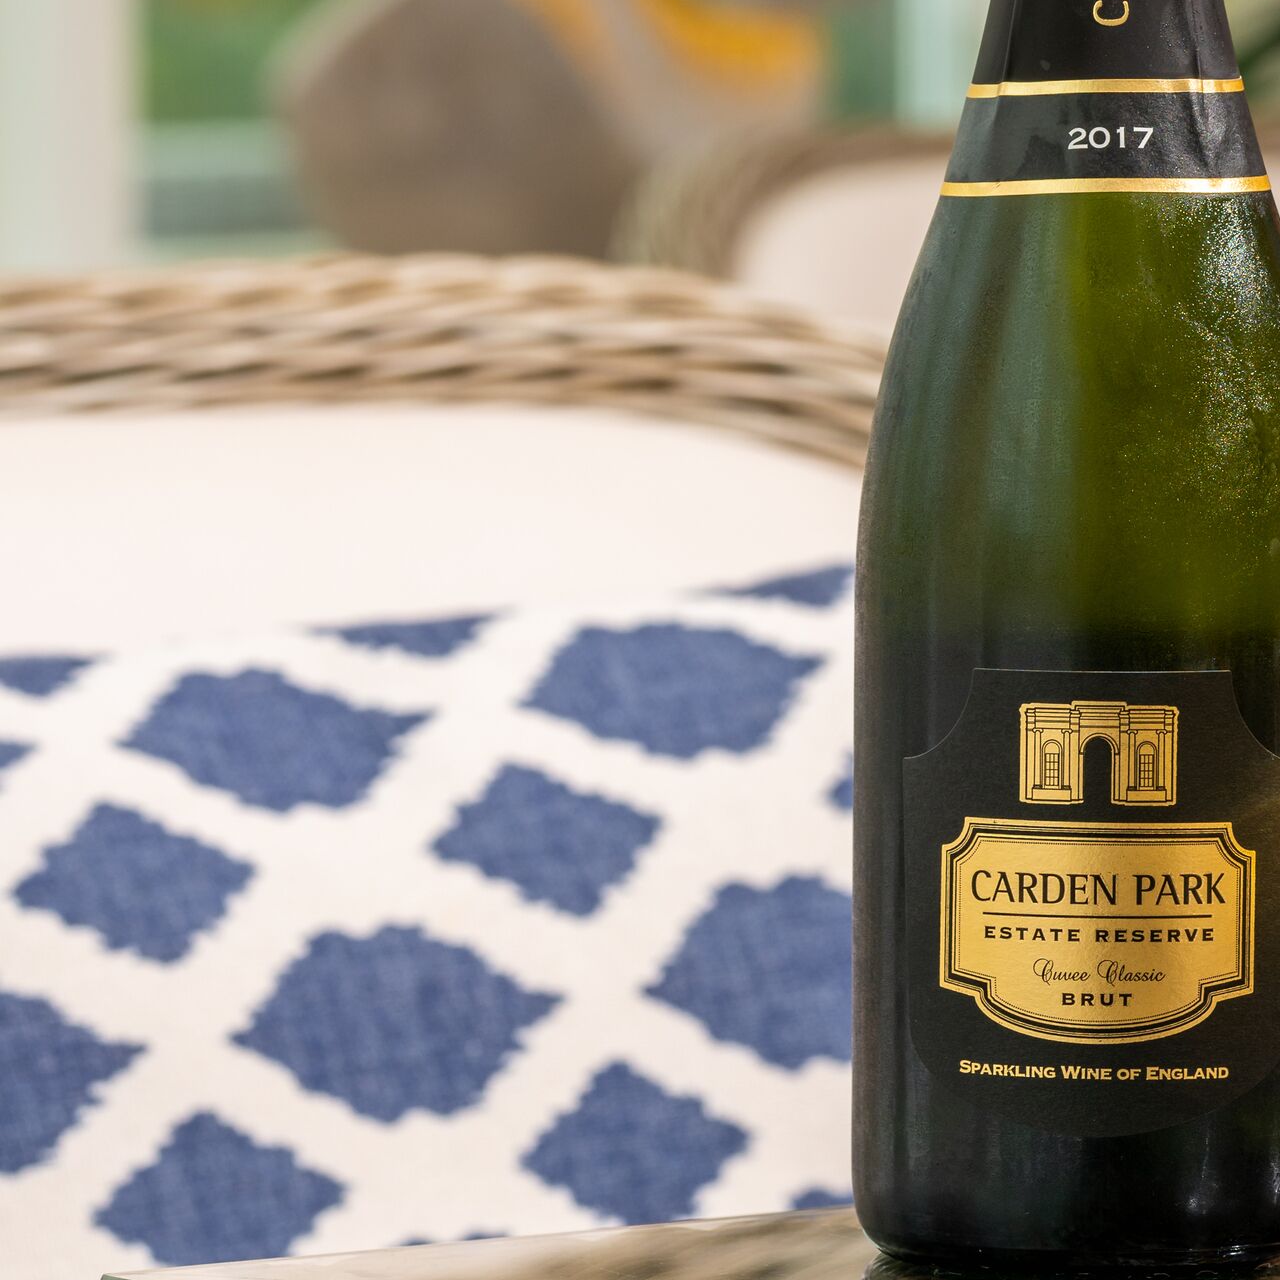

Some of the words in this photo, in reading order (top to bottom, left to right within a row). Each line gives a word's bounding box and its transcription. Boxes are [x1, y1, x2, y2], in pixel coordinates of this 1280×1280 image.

[1066, 125, 1155, 151] 2017
[970, 869, 1118, 906] CARDEN
[1133, 871, 1227, 906] PARK
[983, 925, 1081, 943] ESTATE
[1095, 927, 1215, 944] RESERVE
[1032, 957, 1091, 984] Cuvee
[1096, 958, 1166, 984] Classic
[1061, 992, 1133, 1007] BRUT
[1116, 1067, 1142, 1081] OF
